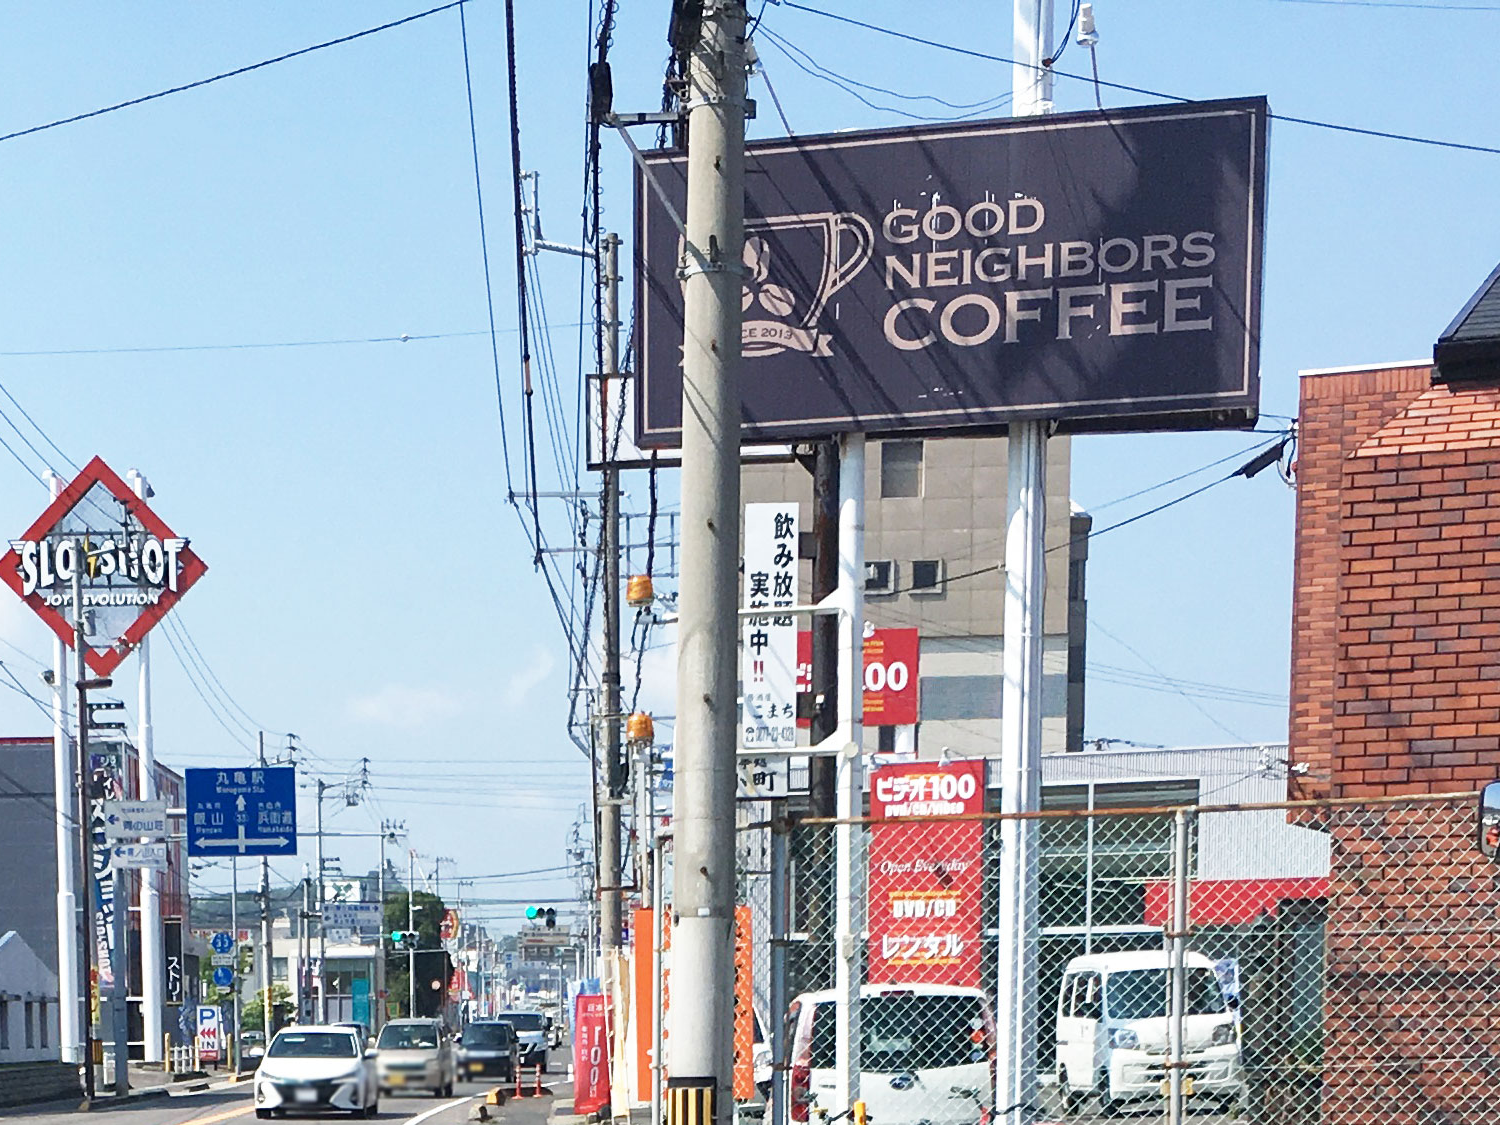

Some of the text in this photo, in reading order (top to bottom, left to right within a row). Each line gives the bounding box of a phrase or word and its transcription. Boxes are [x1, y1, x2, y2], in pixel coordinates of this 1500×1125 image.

[883, 198, 1046, 245] GOOD
[884, 231, 1217, 291] NEIGHBORS
[883, 274, 1214, 352] COFFEE
[760, 327, 794, 341] 2013
[43, 592, 160, 607] JOY EVOLUTION
[862, 661, 909, 692] 00
[876, 772, 976, 802] ビデオ100
[914, 857, 970, 874] Eveday
[893, 898, 957, 918] DVD/CD
[882, 932, 964, 960] レンタル
[199, 1008, 216, 1026] P
[201, 1040, 215, 1050] IN
